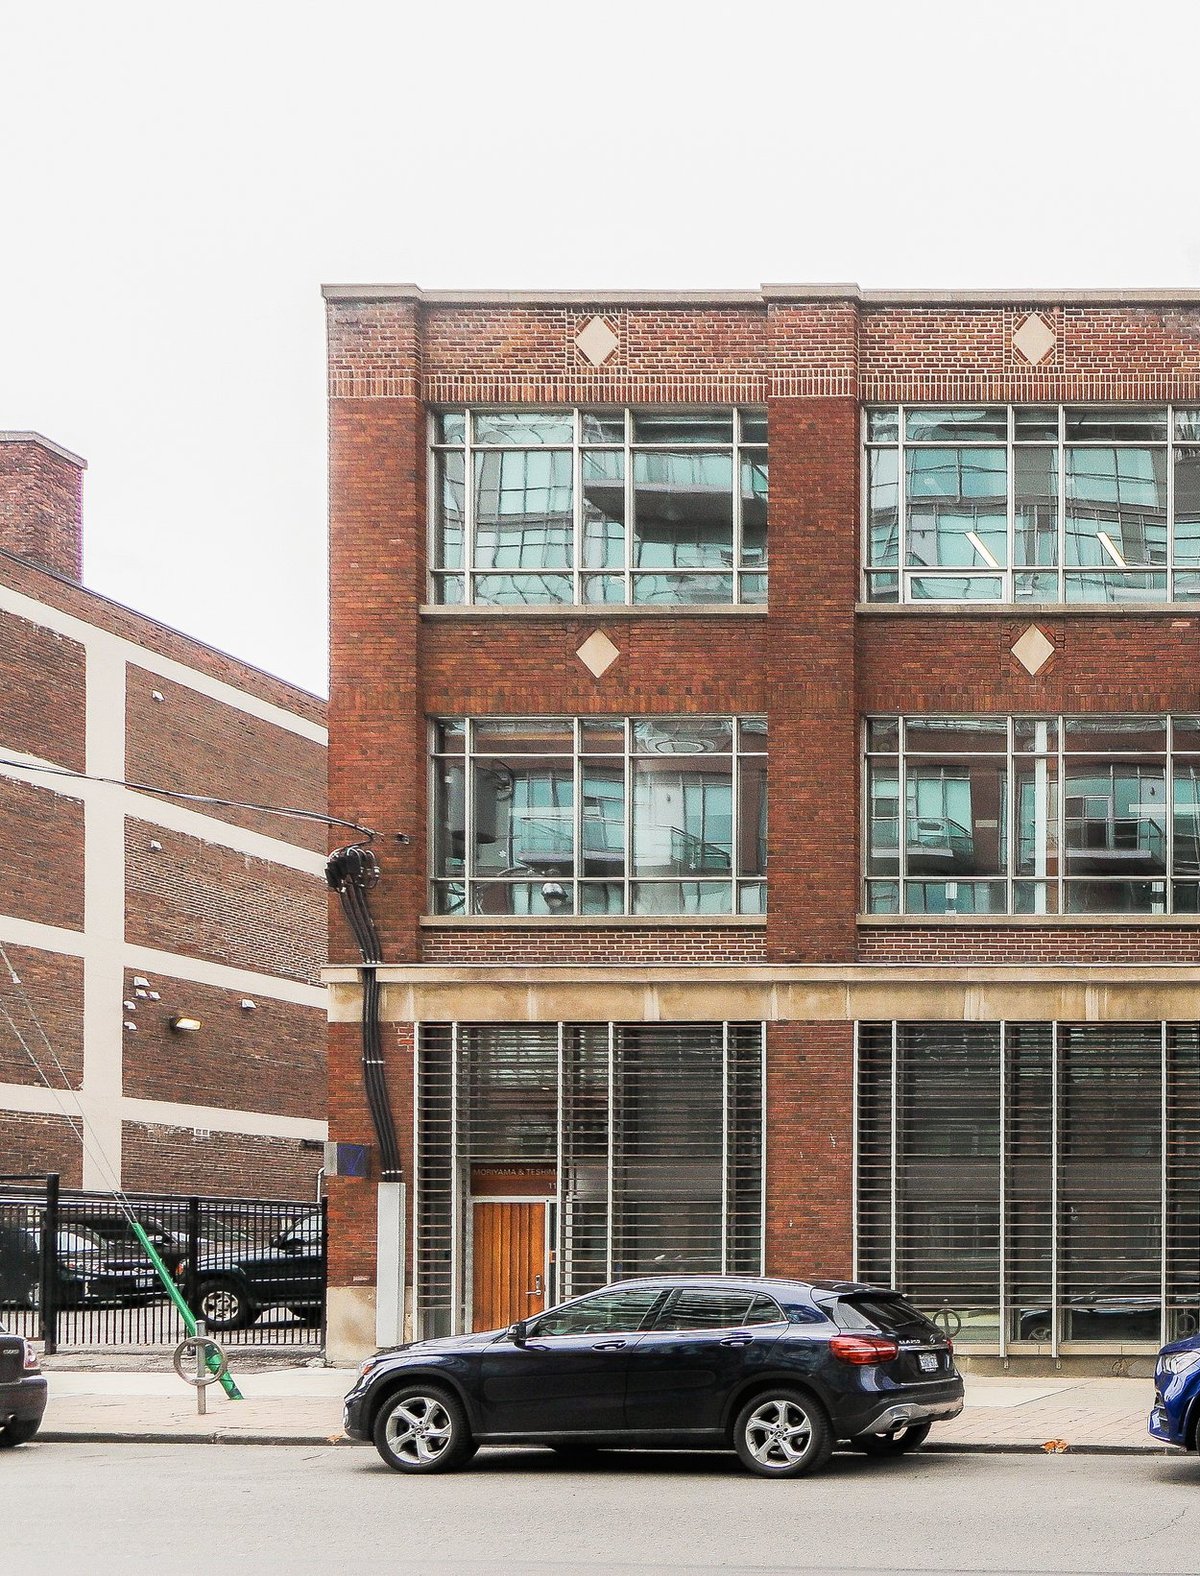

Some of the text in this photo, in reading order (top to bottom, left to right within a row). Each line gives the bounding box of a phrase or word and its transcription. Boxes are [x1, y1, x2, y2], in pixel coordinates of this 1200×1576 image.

[473, 1168, 556, 1176] MORIYAMA & TESHIM
